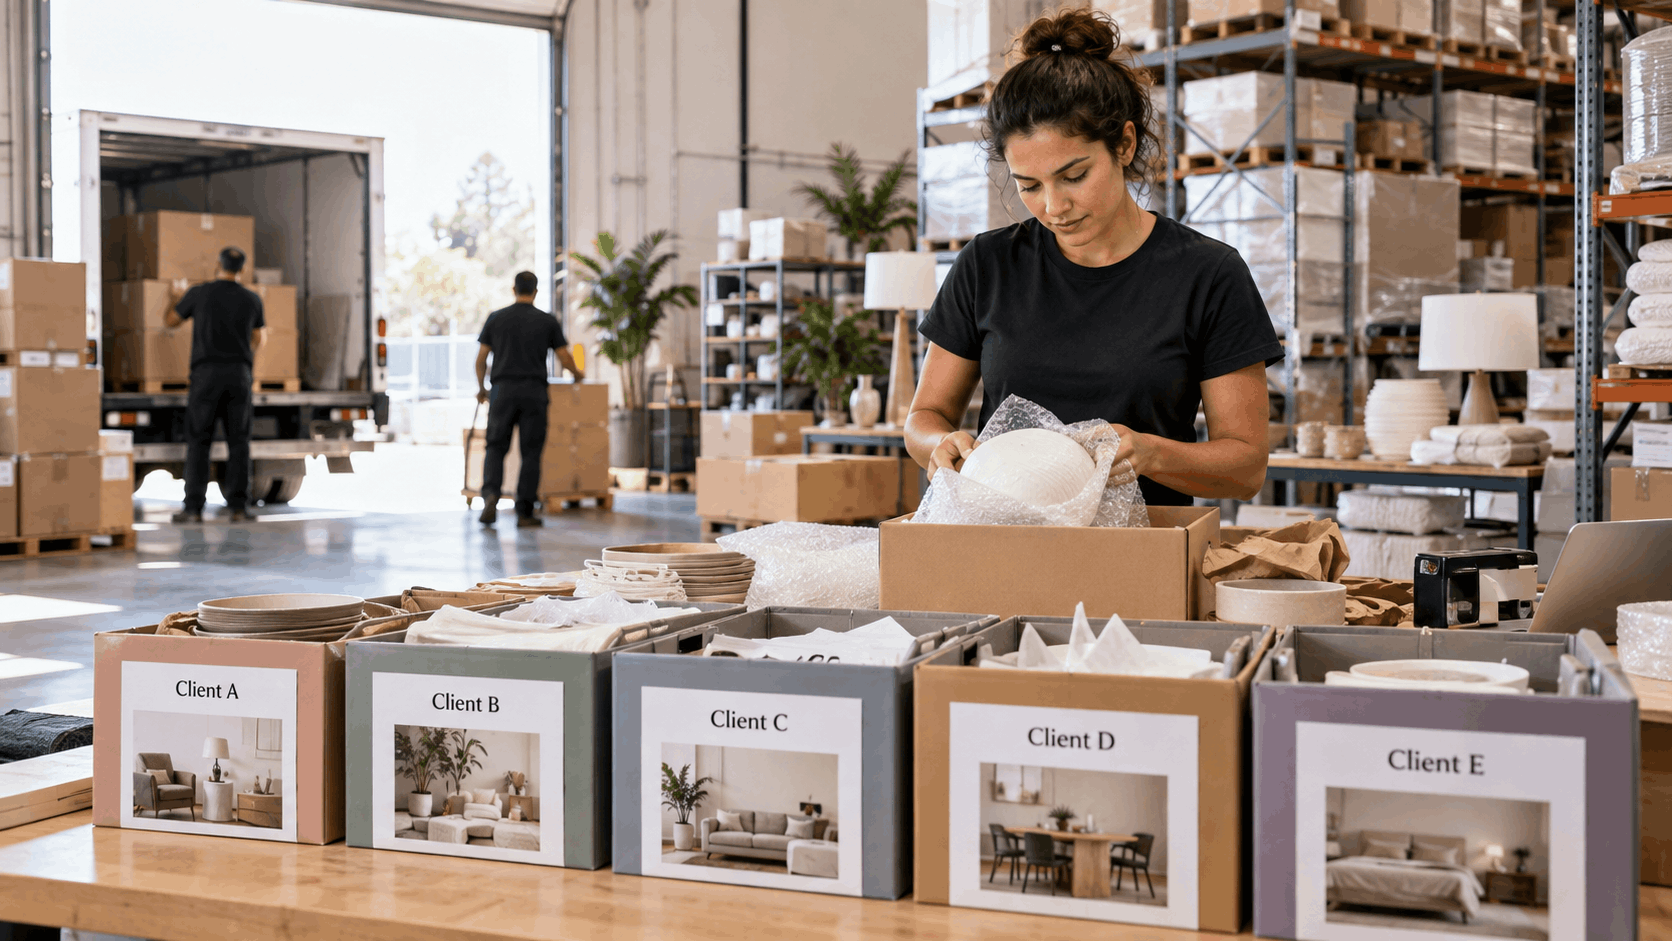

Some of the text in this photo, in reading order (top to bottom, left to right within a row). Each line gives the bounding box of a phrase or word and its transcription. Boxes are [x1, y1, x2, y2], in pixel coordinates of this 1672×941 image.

[175, 679, 240, 700] Client A
[431, 692, 500, 714] Client B
[710, 709, 788, 732] Client C
[1027, 727, 1116, 751] Client D
[1387, 749, 1484, 776] Client E
